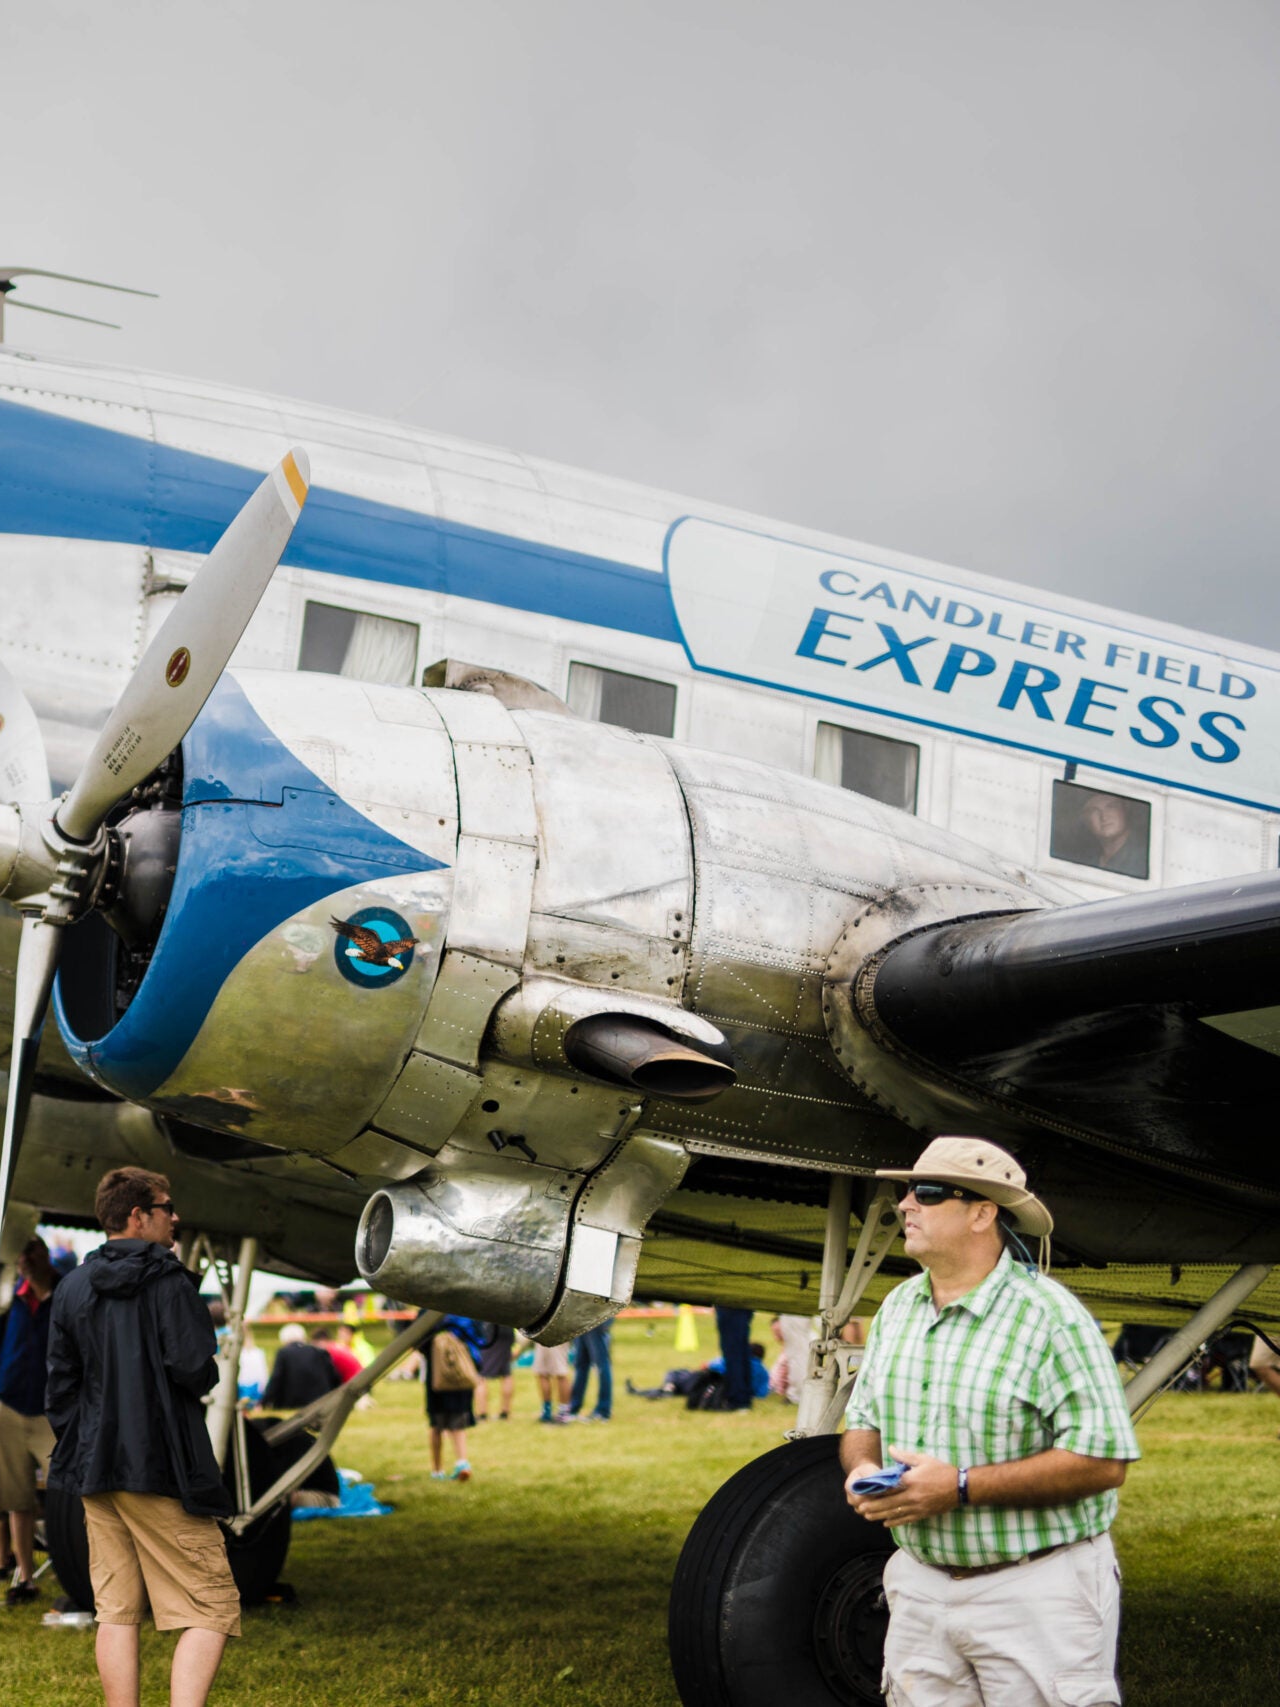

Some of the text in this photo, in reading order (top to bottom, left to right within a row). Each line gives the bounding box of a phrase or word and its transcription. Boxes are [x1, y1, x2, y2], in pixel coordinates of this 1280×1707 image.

[794, 606, 1247, 764] EXPRESS
[818, 569, 1257, 701] CANDLER FIELD
